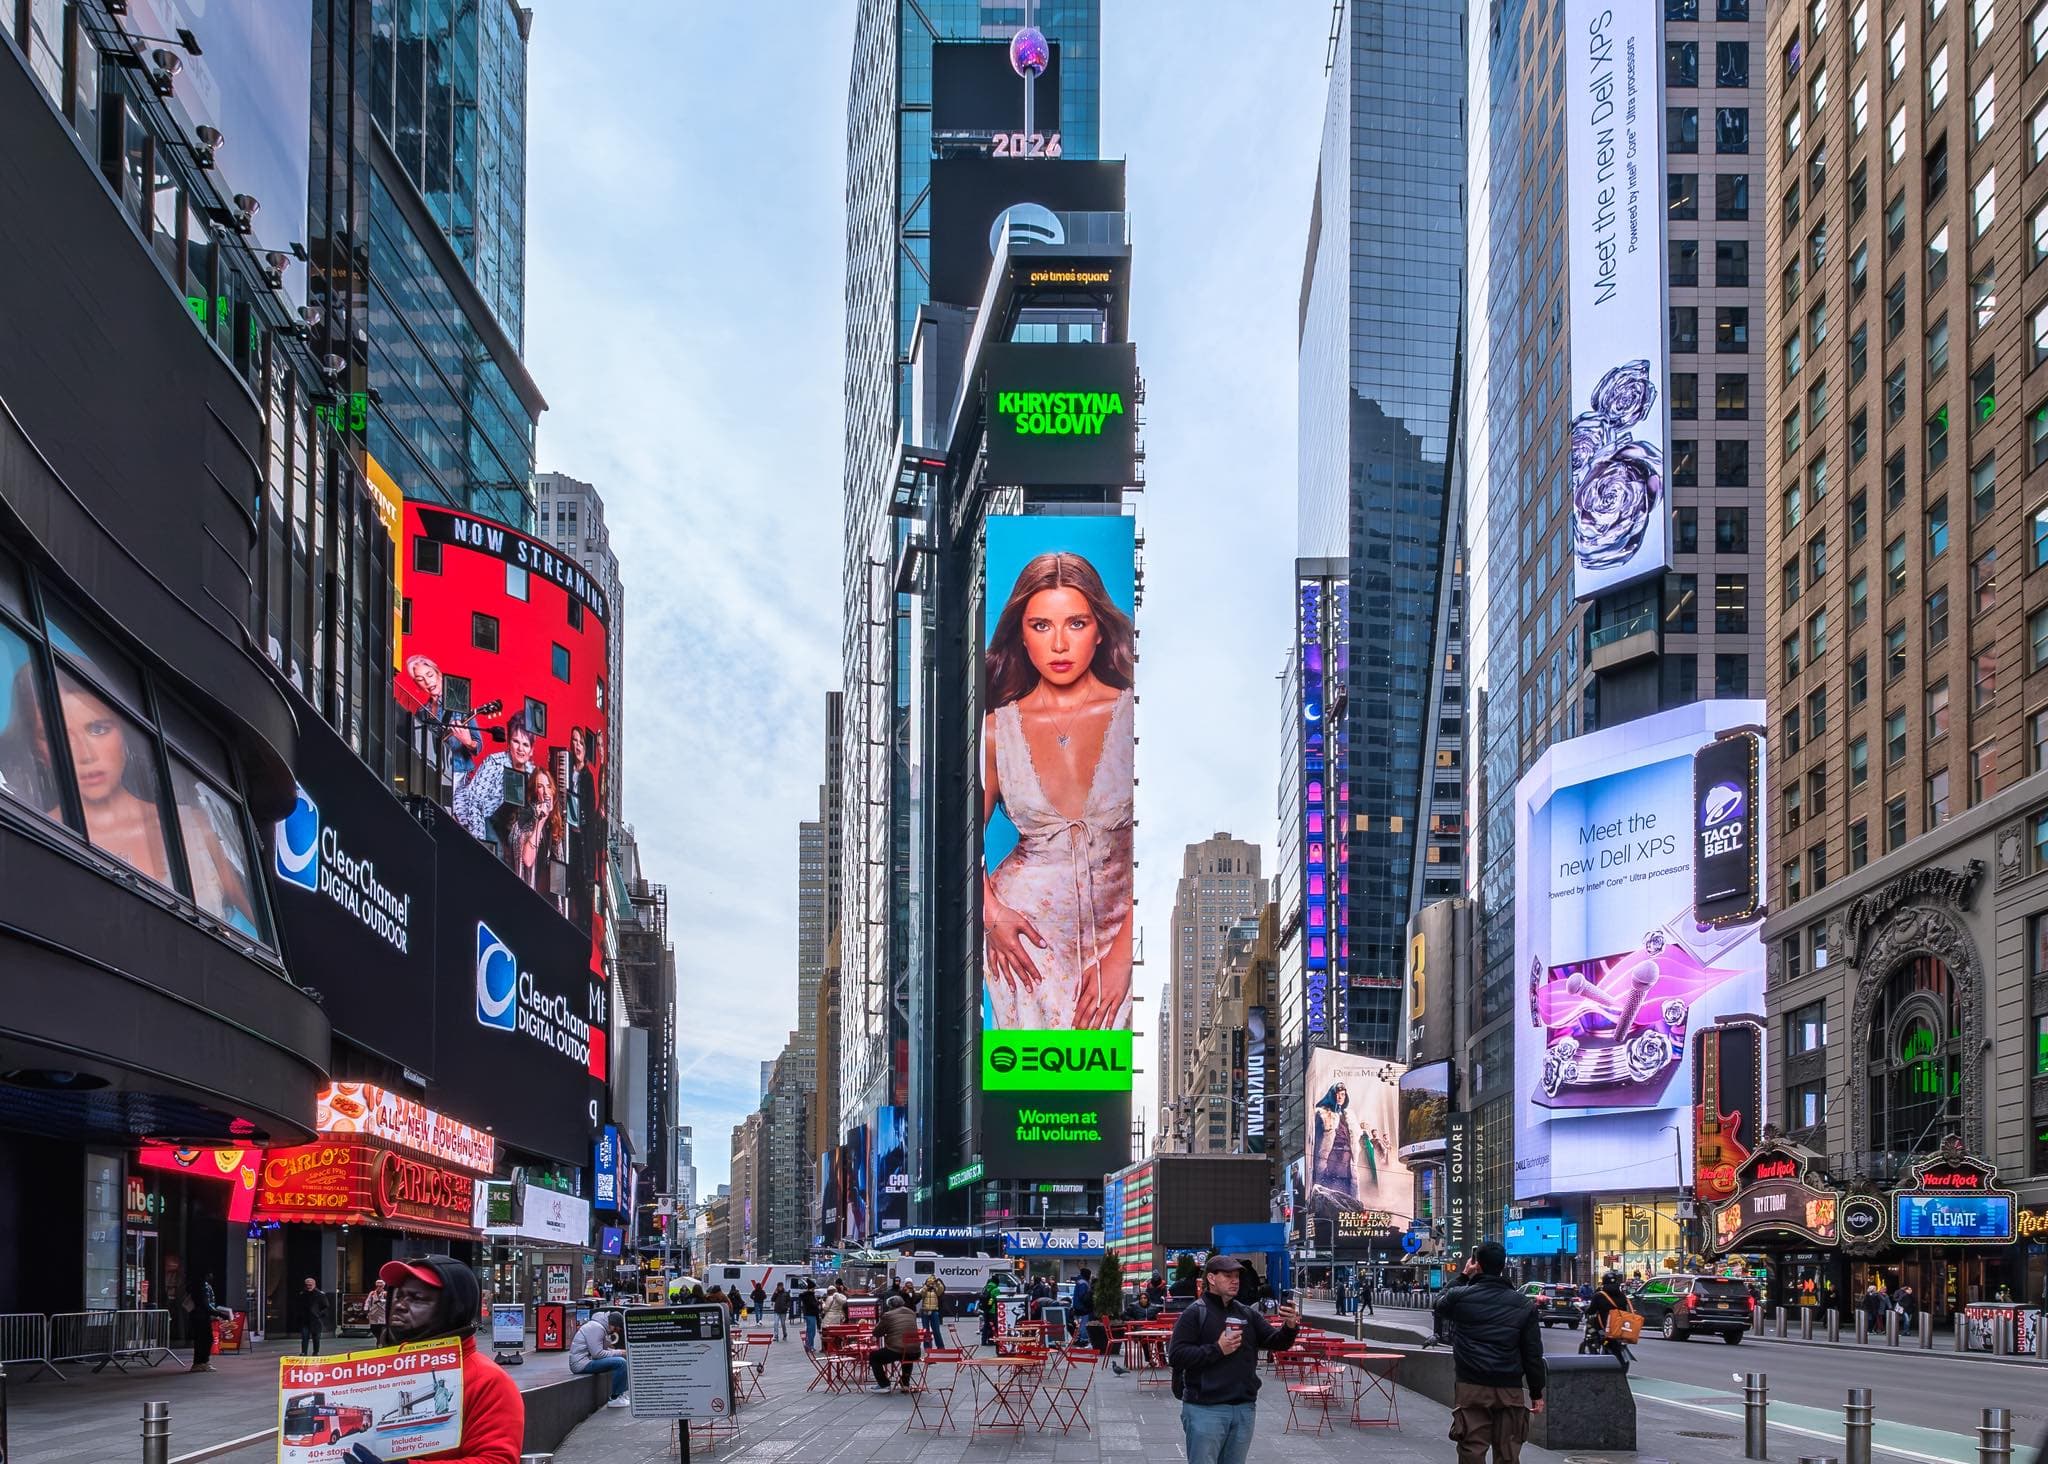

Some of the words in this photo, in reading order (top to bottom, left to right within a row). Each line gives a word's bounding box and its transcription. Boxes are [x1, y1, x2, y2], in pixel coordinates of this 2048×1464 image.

[1589, 9, 1613, 74] XPS
[1627, 37, 1638, 95] processors
[1590, 73, 1614, 126] Dell
[1626, 97, 1637, 125] Ultra
[992, 133, 1062, 158] 2026
[1597, 128, 1615, 184] new
[1629, 189, 1640, 204] by
[1592, 186, 1616, 233] the
[1628, 205, 1638, 253] Powered
[1030, 271, 1049, 285] one
[1050, 269, 1076, 282] times
[1076, 270, 1110, 285] square
[1594, 233, 1617, 306] Meet
[999, 392, 1124, 415] KHRYSTYNA
[1015, 413, 1106, 434] SOLOVIY
[454, 517, 505, 553] NOW
[517, 540, 603, 617] STREAMING
[1579, 820, 1623, 845] Meet
[1628, 812, 1657, 833] the
[1701, 822, 1742, 845] TACO
[1559, 856, 1595, 878] new
[1600, 843, 1631, 869] Dell
[1636, 835, 1676, 861] XPS
[1703, 836, 1744, 859] BELL
[1576, 884, 1585, 895] by
[1629, 872, 1647, 883] Ultra
[1648, 863, 1690, 880] processors
[320, 865, 361, 918] DIGITAL
[361, 900, 408, 955] OUTDOOR
[1308, 975, 1328, 1032] ROKU
[518, 1007, 555, 1047] DIGITAL
[1021, 1046, 1128, 1073] EQUAL
[1018, 1109, 1080, 1124] Women
[1081, 1111, 1098, 1124] at
[1016, 1126, 1040, 1141] full
[1041, 1126, 1102, 1141] volume.
[1452, 1123, 1463, 1183] SQUARE
[264, 1148, 350, 1188] CARLO'S
[1757, 1162, 1777, 1180] Hard
[1776, 1159, 1796, 1179] Rock
[380, 1150, 452, 1210] CARLO'S
[1923, 1172, 1951, 1186] Hard
[1951, 1173, 1979, 1188] Rock
[264, 1191, 305, 1206] BAKE
[307, 1193, 348, 1207] SHOP
[1452, 1197, 1463, 1242] TIMES
[1508, 1207, 1523, 1221] AT&T
[1931, 1211, 1977, 1227] ELEVATE
[935, 1228, 947, 1237] AT
[1006, 1232, 1038, 1249] NEW
[1039, 1232, 1074, 1249] YORK
[1452, 1251, 1464, 1259] 3
[548, 1265, 569, 1274] ATM
[938, 1264, 980, 1277] verizon
[545, 1332, 557, 1341] MJ
[290, 1366, 352, 1387] Hop-On
[356, 1354, 417, 1376] Hop-Off
[420, 1352, 458, 1367] Pass
[331, 1388, 350, 1397] Most
[349, 1384, 378, 1396] frequent
[378, 1382, 392, 1390] bus
[391, 1378, 417, 1389] arrivals
[391, 1434, 425, 1447] Included:
[391, 1443, 417, 1454] Liberty
[417, 1440, 441, 1450] Cruise
[307, 1450, 325, 1459] 40+
